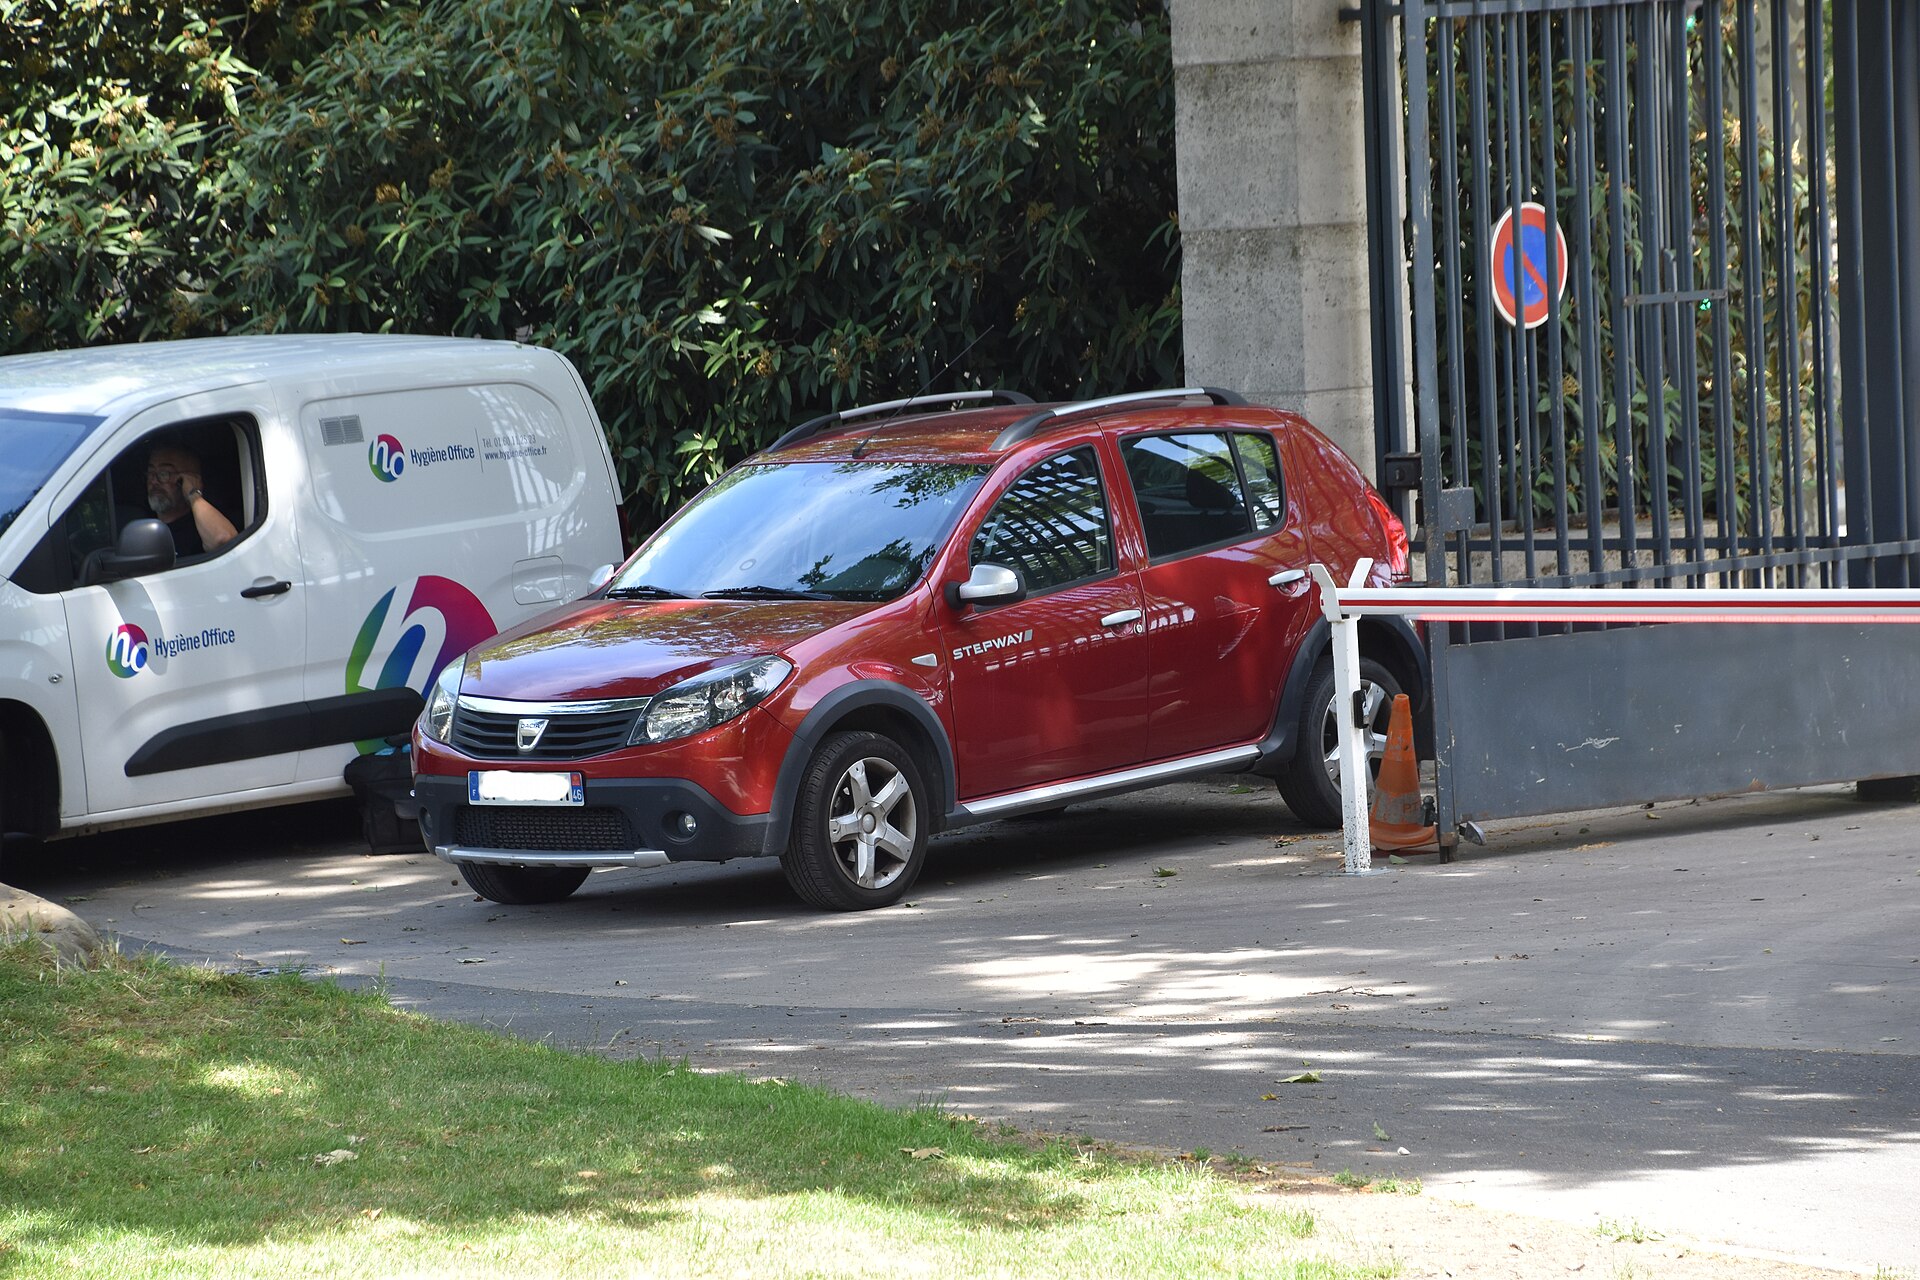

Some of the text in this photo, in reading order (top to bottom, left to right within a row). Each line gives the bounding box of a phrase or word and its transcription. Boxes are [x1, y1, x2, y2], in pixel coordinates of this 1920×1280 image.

[410, 444, 475, 467] Hygiène Office
[154, 627, 235, 659] Hygiène Office
[952, 631, 1024, 660] STEPWAY
[572, 789, 582, 800] 46
